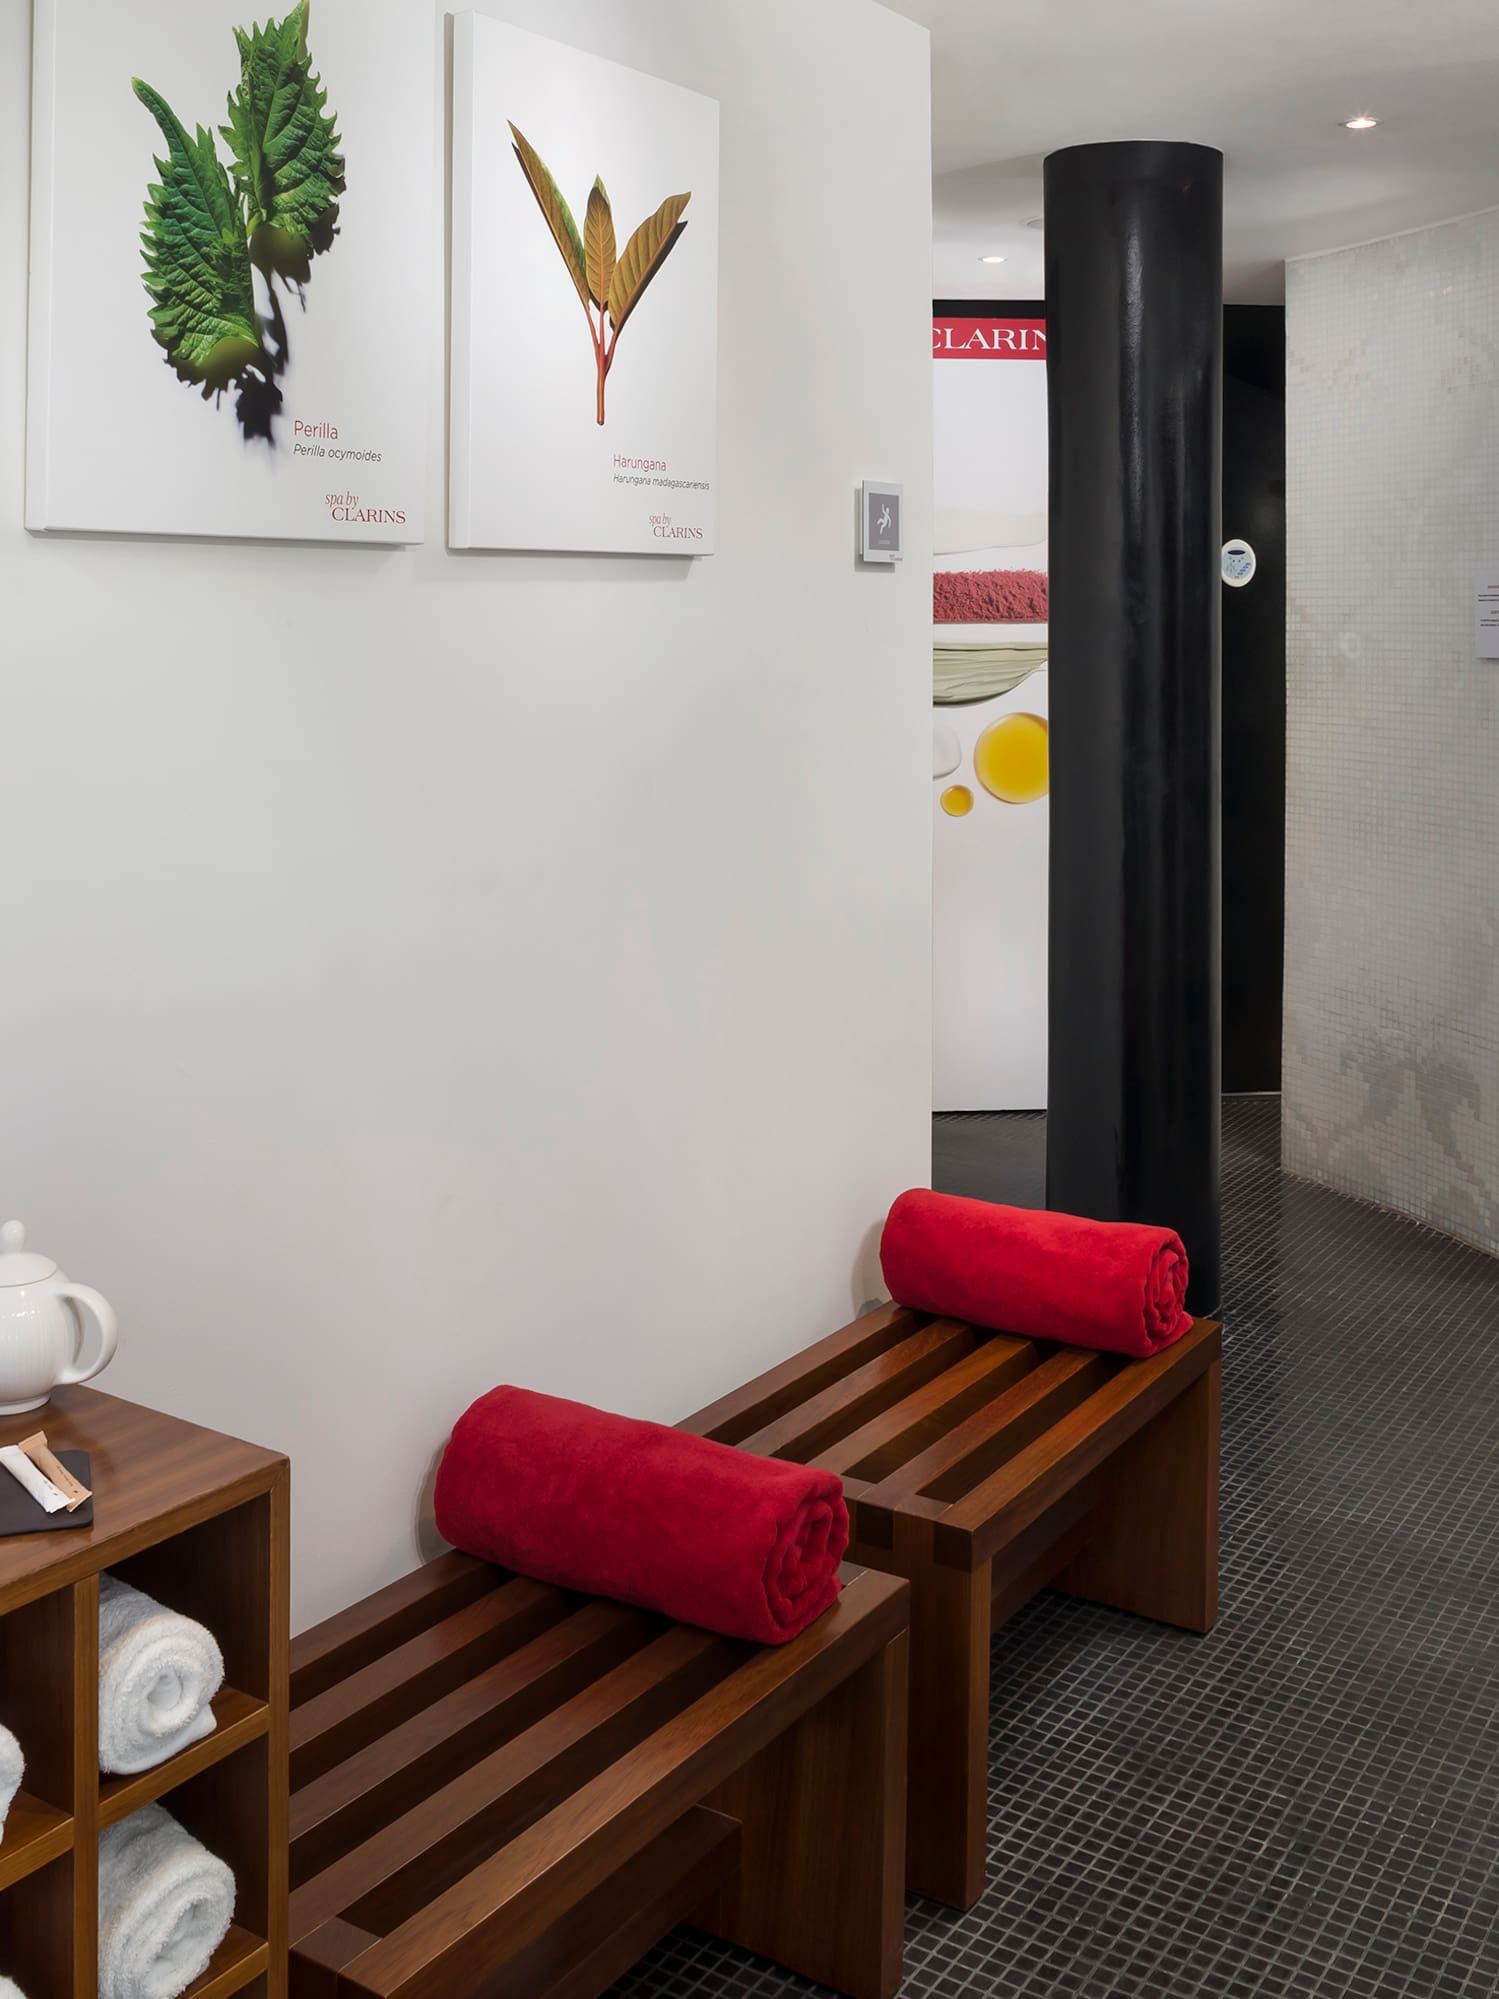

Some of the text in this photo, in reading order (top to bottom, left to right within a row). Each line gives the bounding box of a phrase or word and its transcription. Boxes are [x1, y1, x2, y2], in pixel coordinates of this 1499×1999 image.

[294, 420, 338, 439] Perilla
[293, 443, 382, 462] Perilla ocymoides
[613, 454, 666, 472] Harungana
[613, 473, 710, 490] Harungana madagascariensis
[325, 491, 359, 509] spa by
[332, 507, 406, 524] CLARINS
[649, 512, 671, 527] spa by
[653, 526, 703, 539] CLARINS
